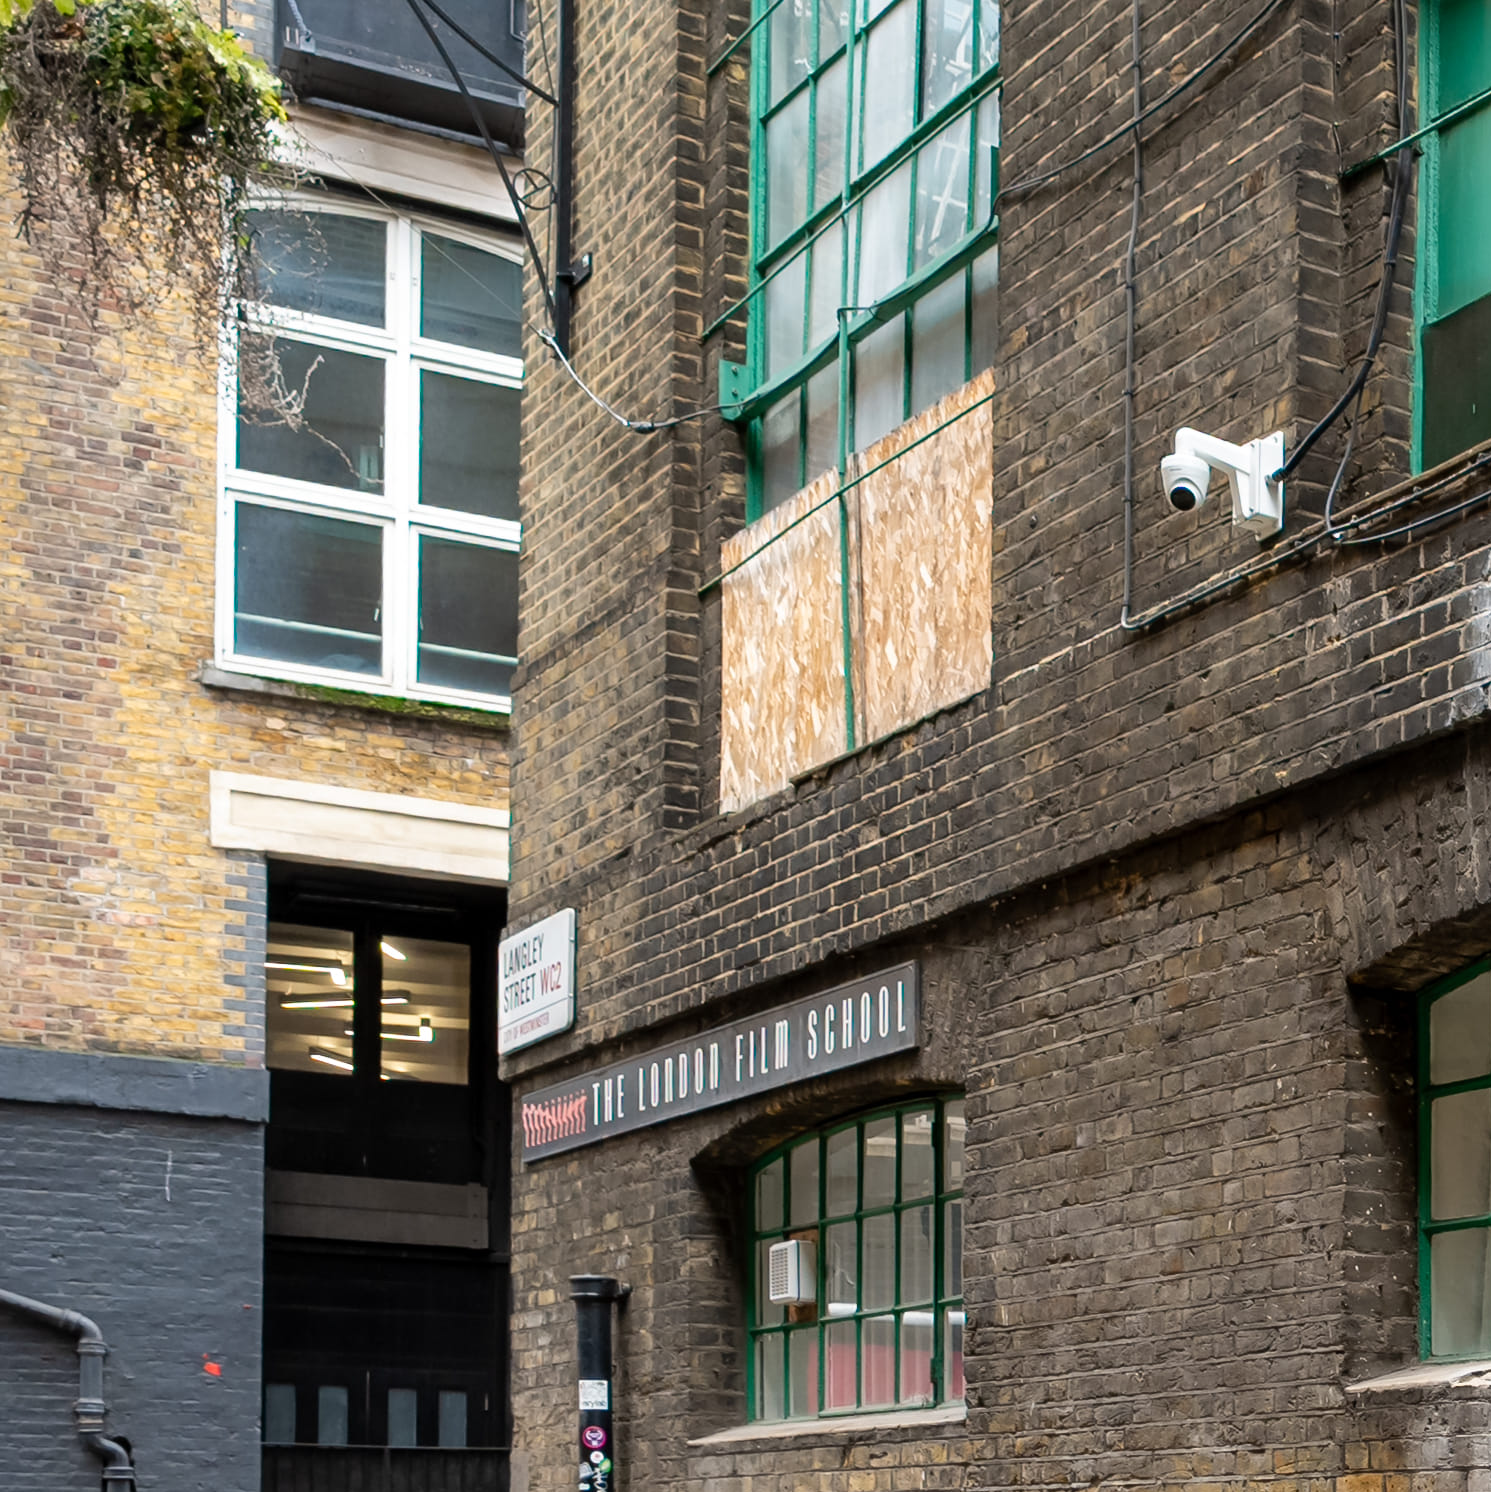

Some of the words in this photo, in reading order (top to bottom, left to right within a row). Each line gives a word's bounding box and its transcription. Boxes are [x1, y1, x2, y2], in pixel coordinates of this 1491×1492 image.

[504, 933, 544, 979] LANGLEY
[504, 973, 536, 1013] STREET
[540, 961, 562, 996] WC2
[592, 1074, 624, 1126] THE
[808, 980, 906, 1059] SCHOOL
